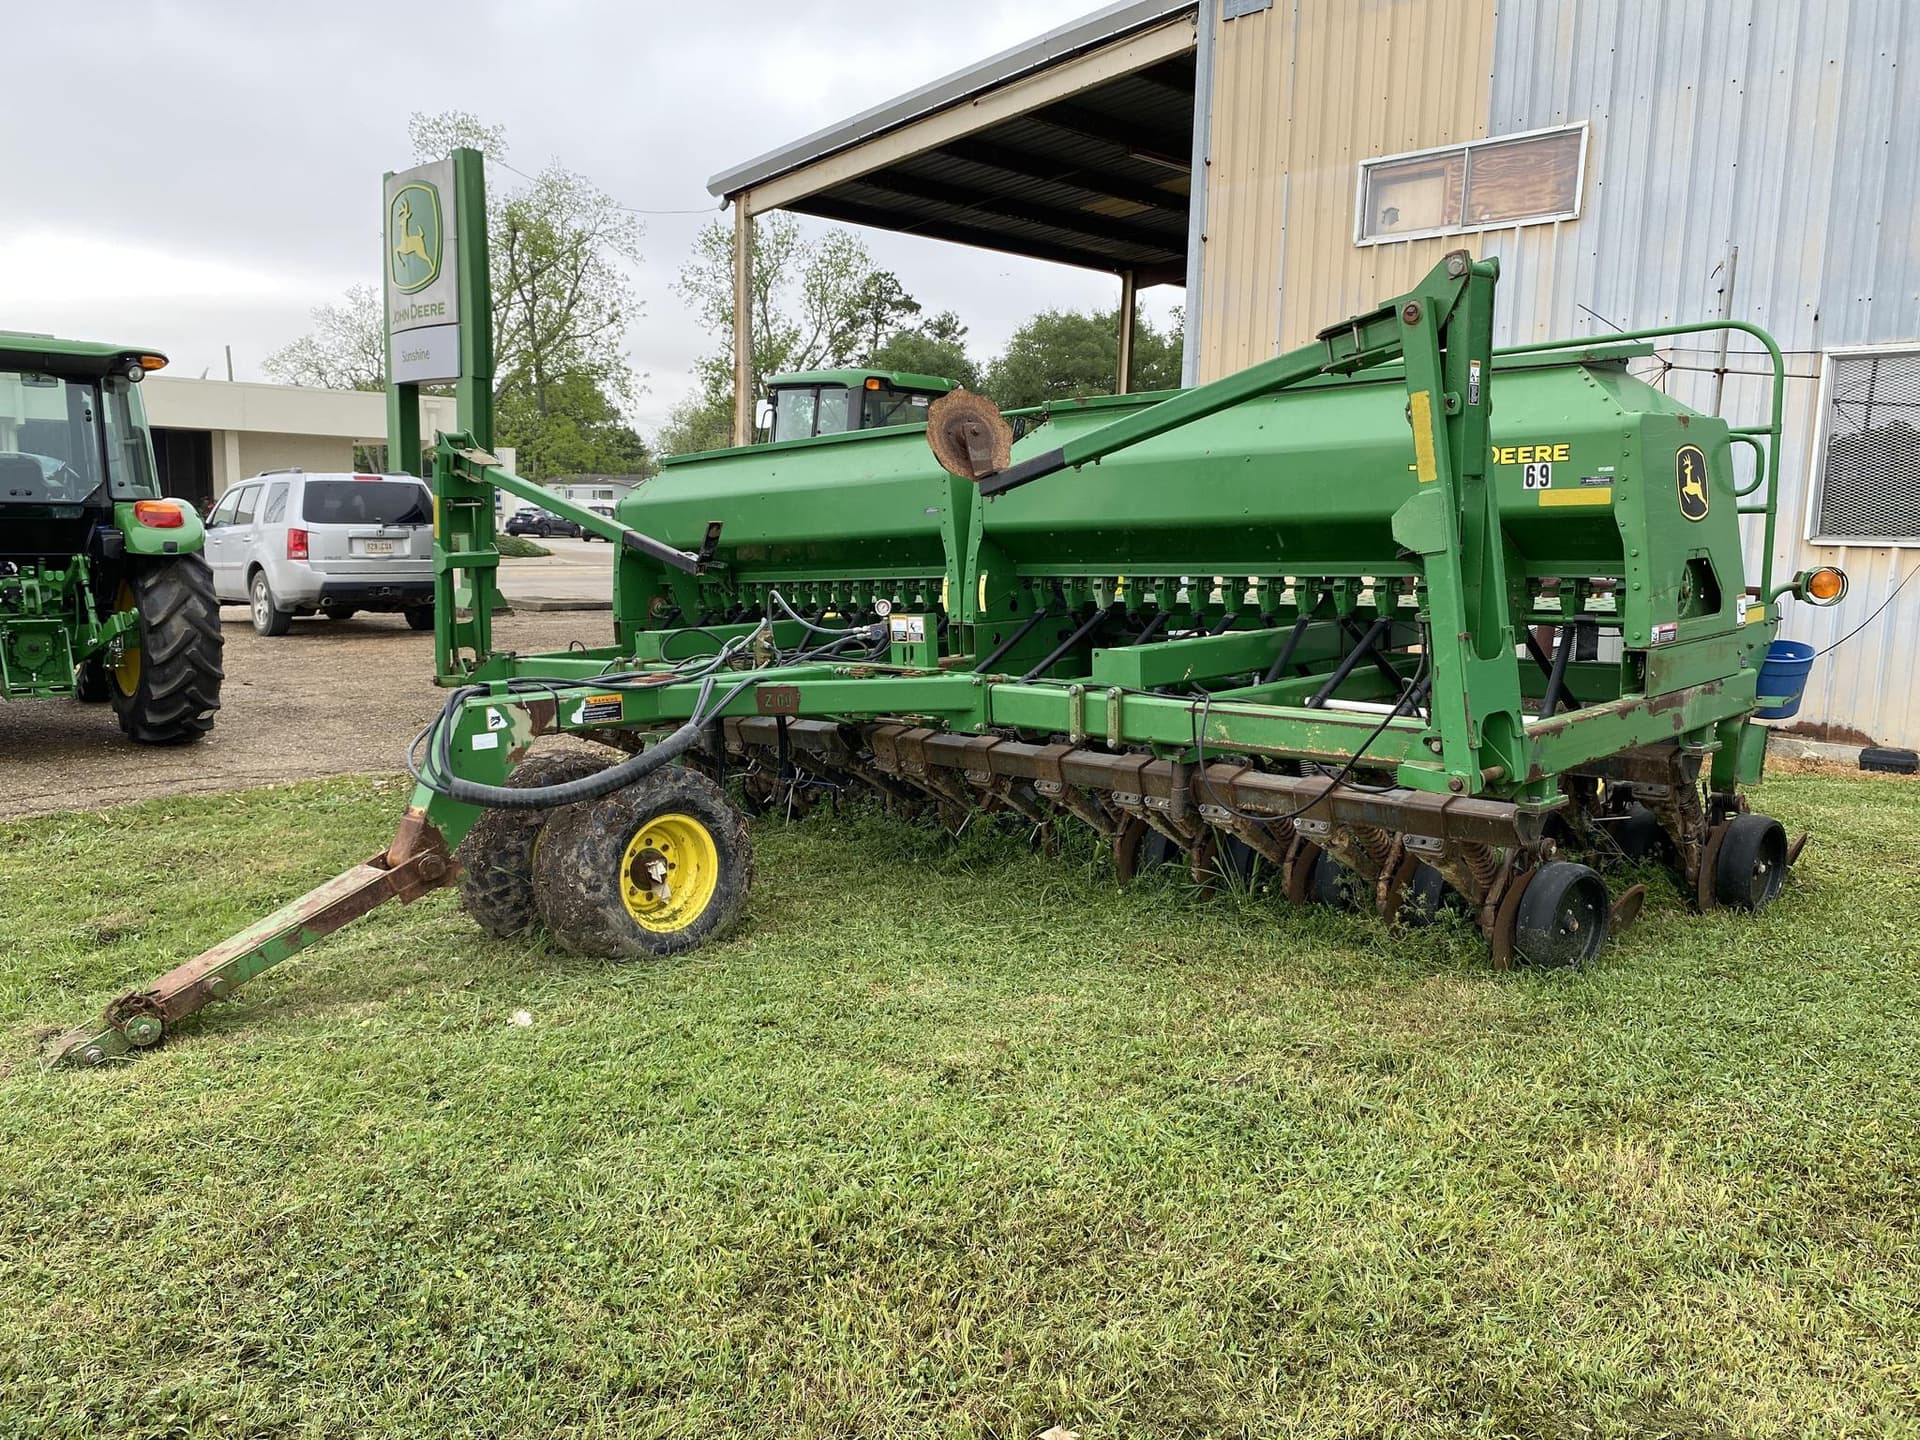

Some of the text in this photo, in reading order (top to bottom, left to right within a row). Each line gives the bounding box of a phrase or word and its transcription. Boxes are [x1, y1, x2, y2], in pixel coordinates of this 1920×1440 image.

[410, 302, 446, 320] DEERE
[401, 346, 431, 363] Sunshine
[1525, 464, 1550, 488] 69
